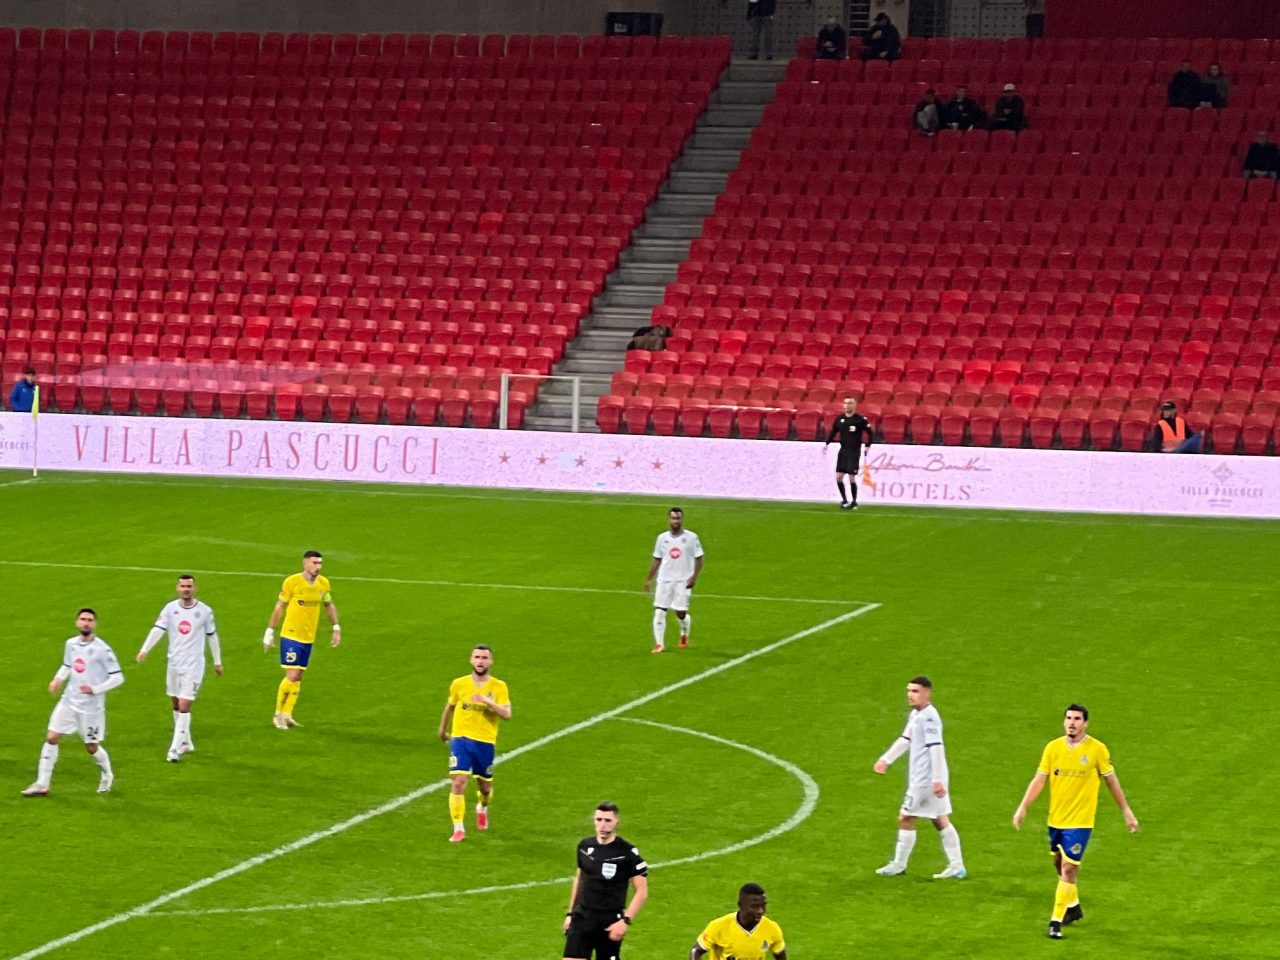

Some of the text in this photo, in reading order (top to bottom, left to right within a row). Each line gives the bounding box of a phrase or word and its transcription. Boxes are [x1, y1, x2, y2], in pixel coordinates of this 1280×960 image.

[75, 424, 439, 476] VILLA PASCUCCI
[871, 482, 972, 502] HOTELS
